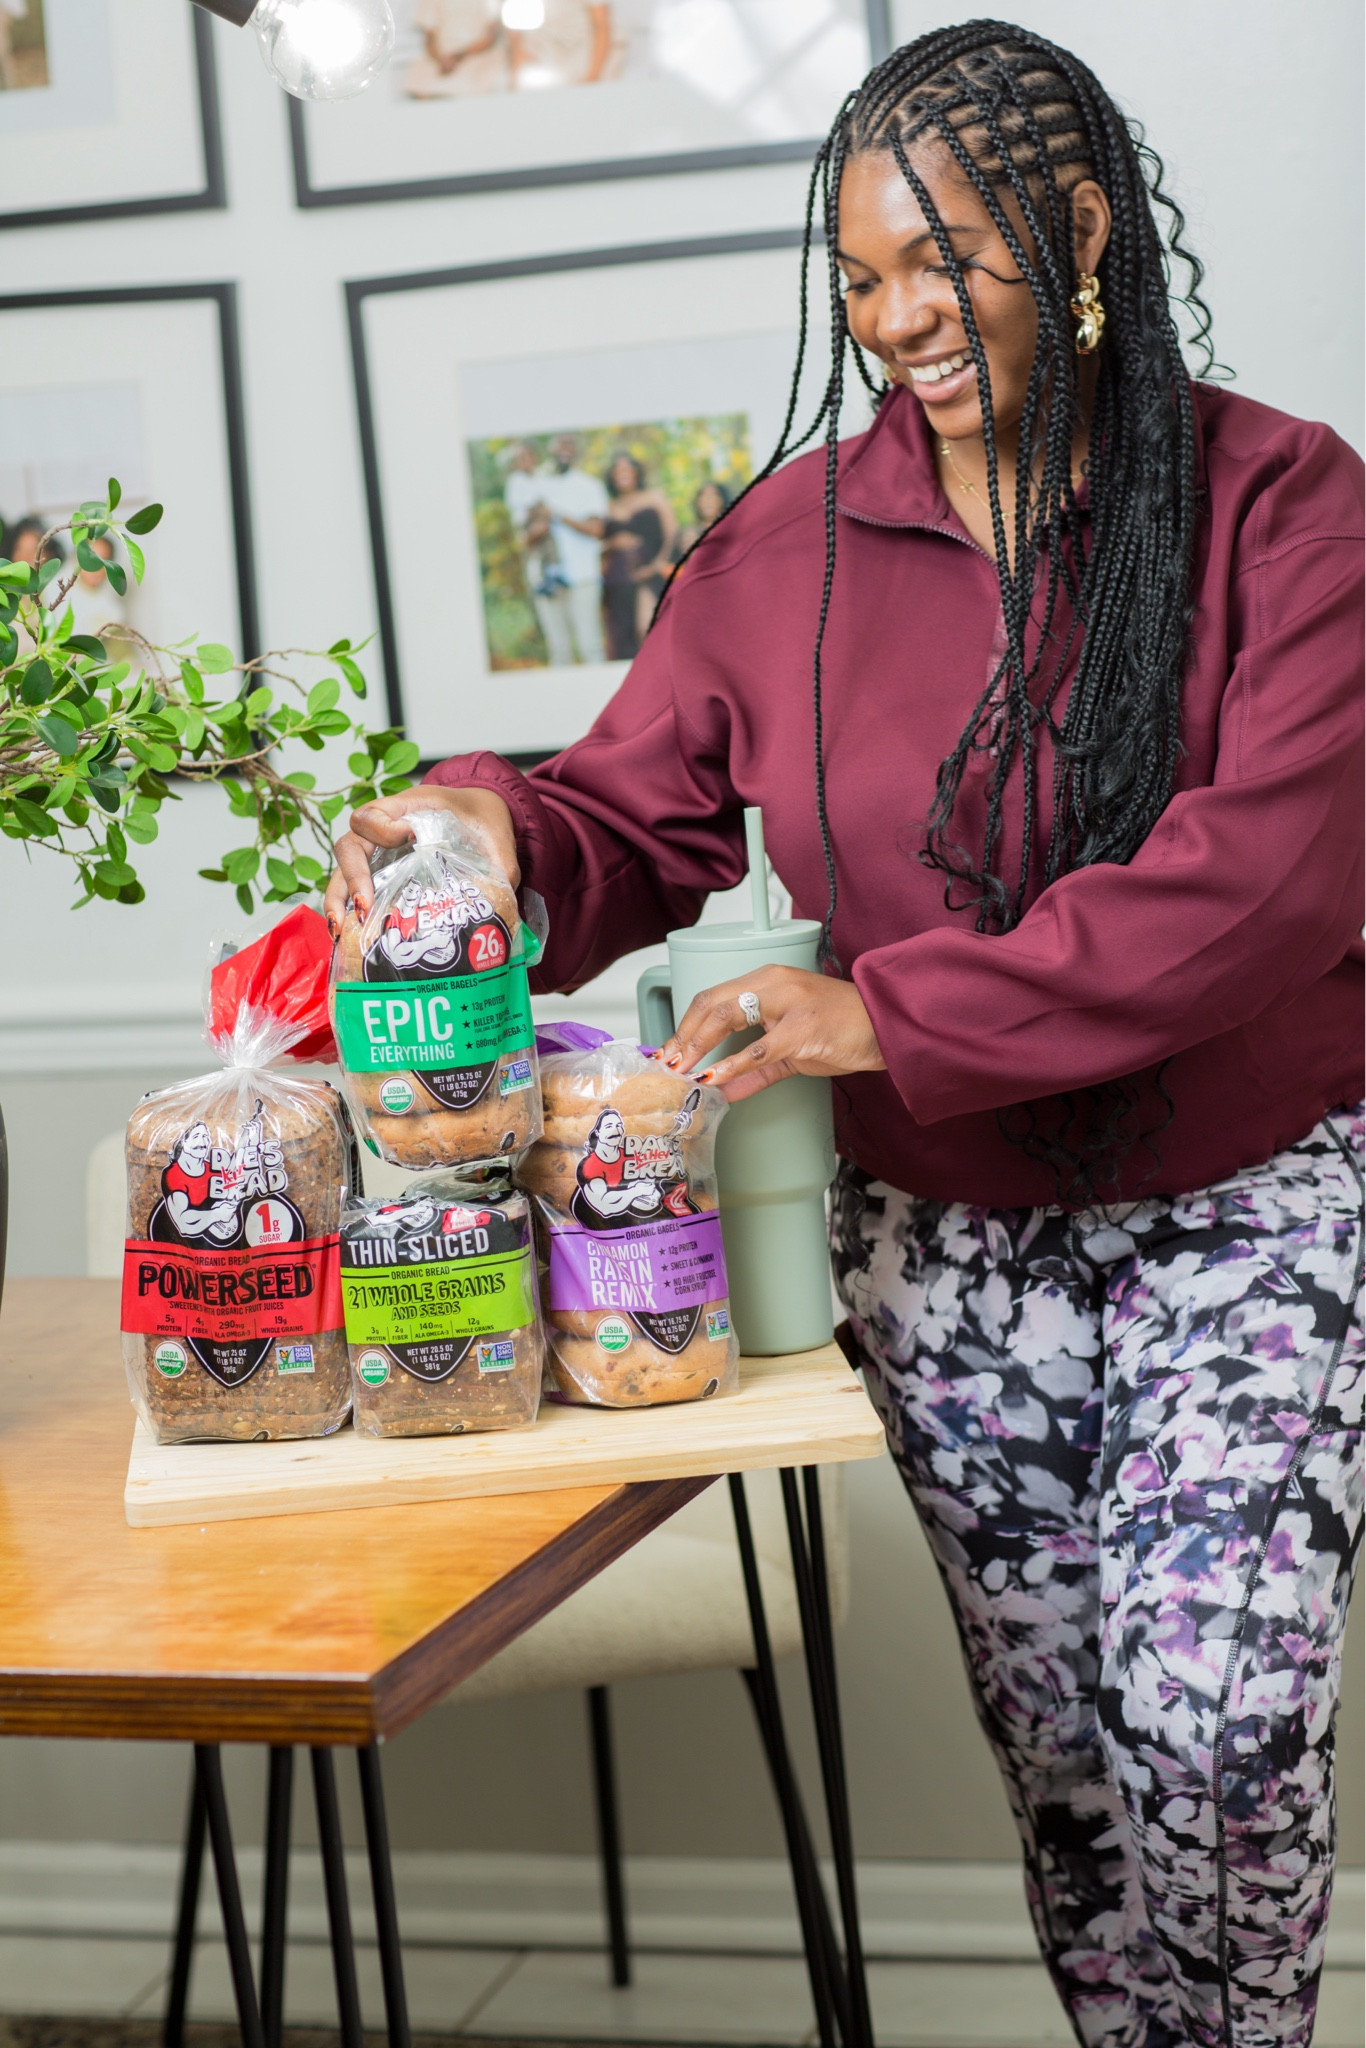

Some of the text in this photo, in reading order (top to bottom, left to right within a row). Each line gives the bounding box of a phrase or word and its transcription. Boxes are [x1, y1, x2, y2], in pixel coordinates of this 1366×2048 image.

[419, 879, 483, 908] DAE'S
[416, 977, 478, 994] ORGANIC BAGELS
[472, 1001, 484, 1011] 13g
[362, 995, 454, 1044] EPIC
[473, 1014, 495, 1027] KILLER
[503, 1023, 527, 1037] MEGA-3
[370, 1042, 455, 1064] EVERYTHING
[513, 1061, 528, 1071] NON
[514, 1066, 530, 1076] GMO
[433, 1070, 483, 1084] NET WT 16.75 OZ
[387, 1086, 406, 1095] USDA
[446, 1083, 454, 1092] LB
[454, 1081, 468, 1091] 0.75
[468, 1079, 479, 1089] OZ)
[385, 1096, 410, 1105] ORGANIC
[452, 1089, 468, 1099] 475g
[210, 1140, 283, 1171] DE'S
[624, 1155, 685, 1180] BREA
[209, 1168, 289, 1201] BREAD
[255, 1202, 281, 1234] 1g
[626, 1222, 680, 1241] ORGANIC BAGELS
[347, 1227, 490, 1266] THIN-SLICED
[586, 1240, 649, 1262] CINNAMON
[667, 1240, 698, 1256] 12g PROTEIN
[194, 1255, 249, 1267] ORGANIC BREAD
[670, 1260, 689, 1271] SWEET
[391, 1266, 450, 1280] ORGANIC BREAD
[588, 1256, 654, 1285] RAISIN
[138, 1261, 316, 1306] POWERSEED
[673, 1278, 682, 1286] NO
[682, 1274, 696, 1285] HIGH
[347, 1272, 506, 1310] 21 WHOLE GRAINS
[591, 1280, 658, 1310] REMIX
[674, 1285, 691, 1296] CORN
[216, 1305, 244, 1316] ORGANIC
[244, 1303, 262, 1313] FRUIT
[263, 1301, 284, 1312] JUICES
[391, 1301, 462, 1322] AND SEEDS
[165, 1314, 175, 1324] 5g
[218, 1319, 245, 1330] 290mg
[274, 1315, 287, 1325] 19g
[370, 1317, 480, 1335] 3g 2g 140mg 12g
[658, 1318, 667, 1327] WT
[683, 1314, 690, 1323] OZ
[156, 1325, 182, 1333] PROTEIN
[192, 1326, 208, 1335] FIBER
[260, 1326, 281, 1334] WHOLE
[281, 1325, 304, 1333] GRAINS
[365, 1324, 495, 1342] PROTEIN FIBER ALA OMEGA-3 WHOLE GRAINS
[604, 1326, 624, 1335] USDA
[666, 1324, 678, 1334] 0.75
[601, 1335, 626, 1344] ORGANIC
[665, 1333, 680, 1343] 475g
[294, 1346, 310, 1354] NON
[407, 1343, 454, 1357] NET WT 20.5 OZ
[496, 1342, 512, 1350] NON
[496, 1348, 513, 1356] GMO
[161, 1350, 179, 1359] USDA
[221, 1350, 231, 1358] WT
[231, 1349, 238, 1357] 25
[238, 1348, 247, 1356] OZ
[419, 1355, 428, 1364] LB
[428, 1353, 439, 1363] 4.5
[439, 1352, 451, 1361] OZ)
[221, 1357, 229, 1366] LB
[234, 1356, 245, 1365] OZ)
[278, 1362, 313, 1370] VERIFIED
[364, 1359, 383, 1368] USDA
[424, 1362, 440, 1371] 581g
[363, 1368, 385, 1377] ORGANIC
